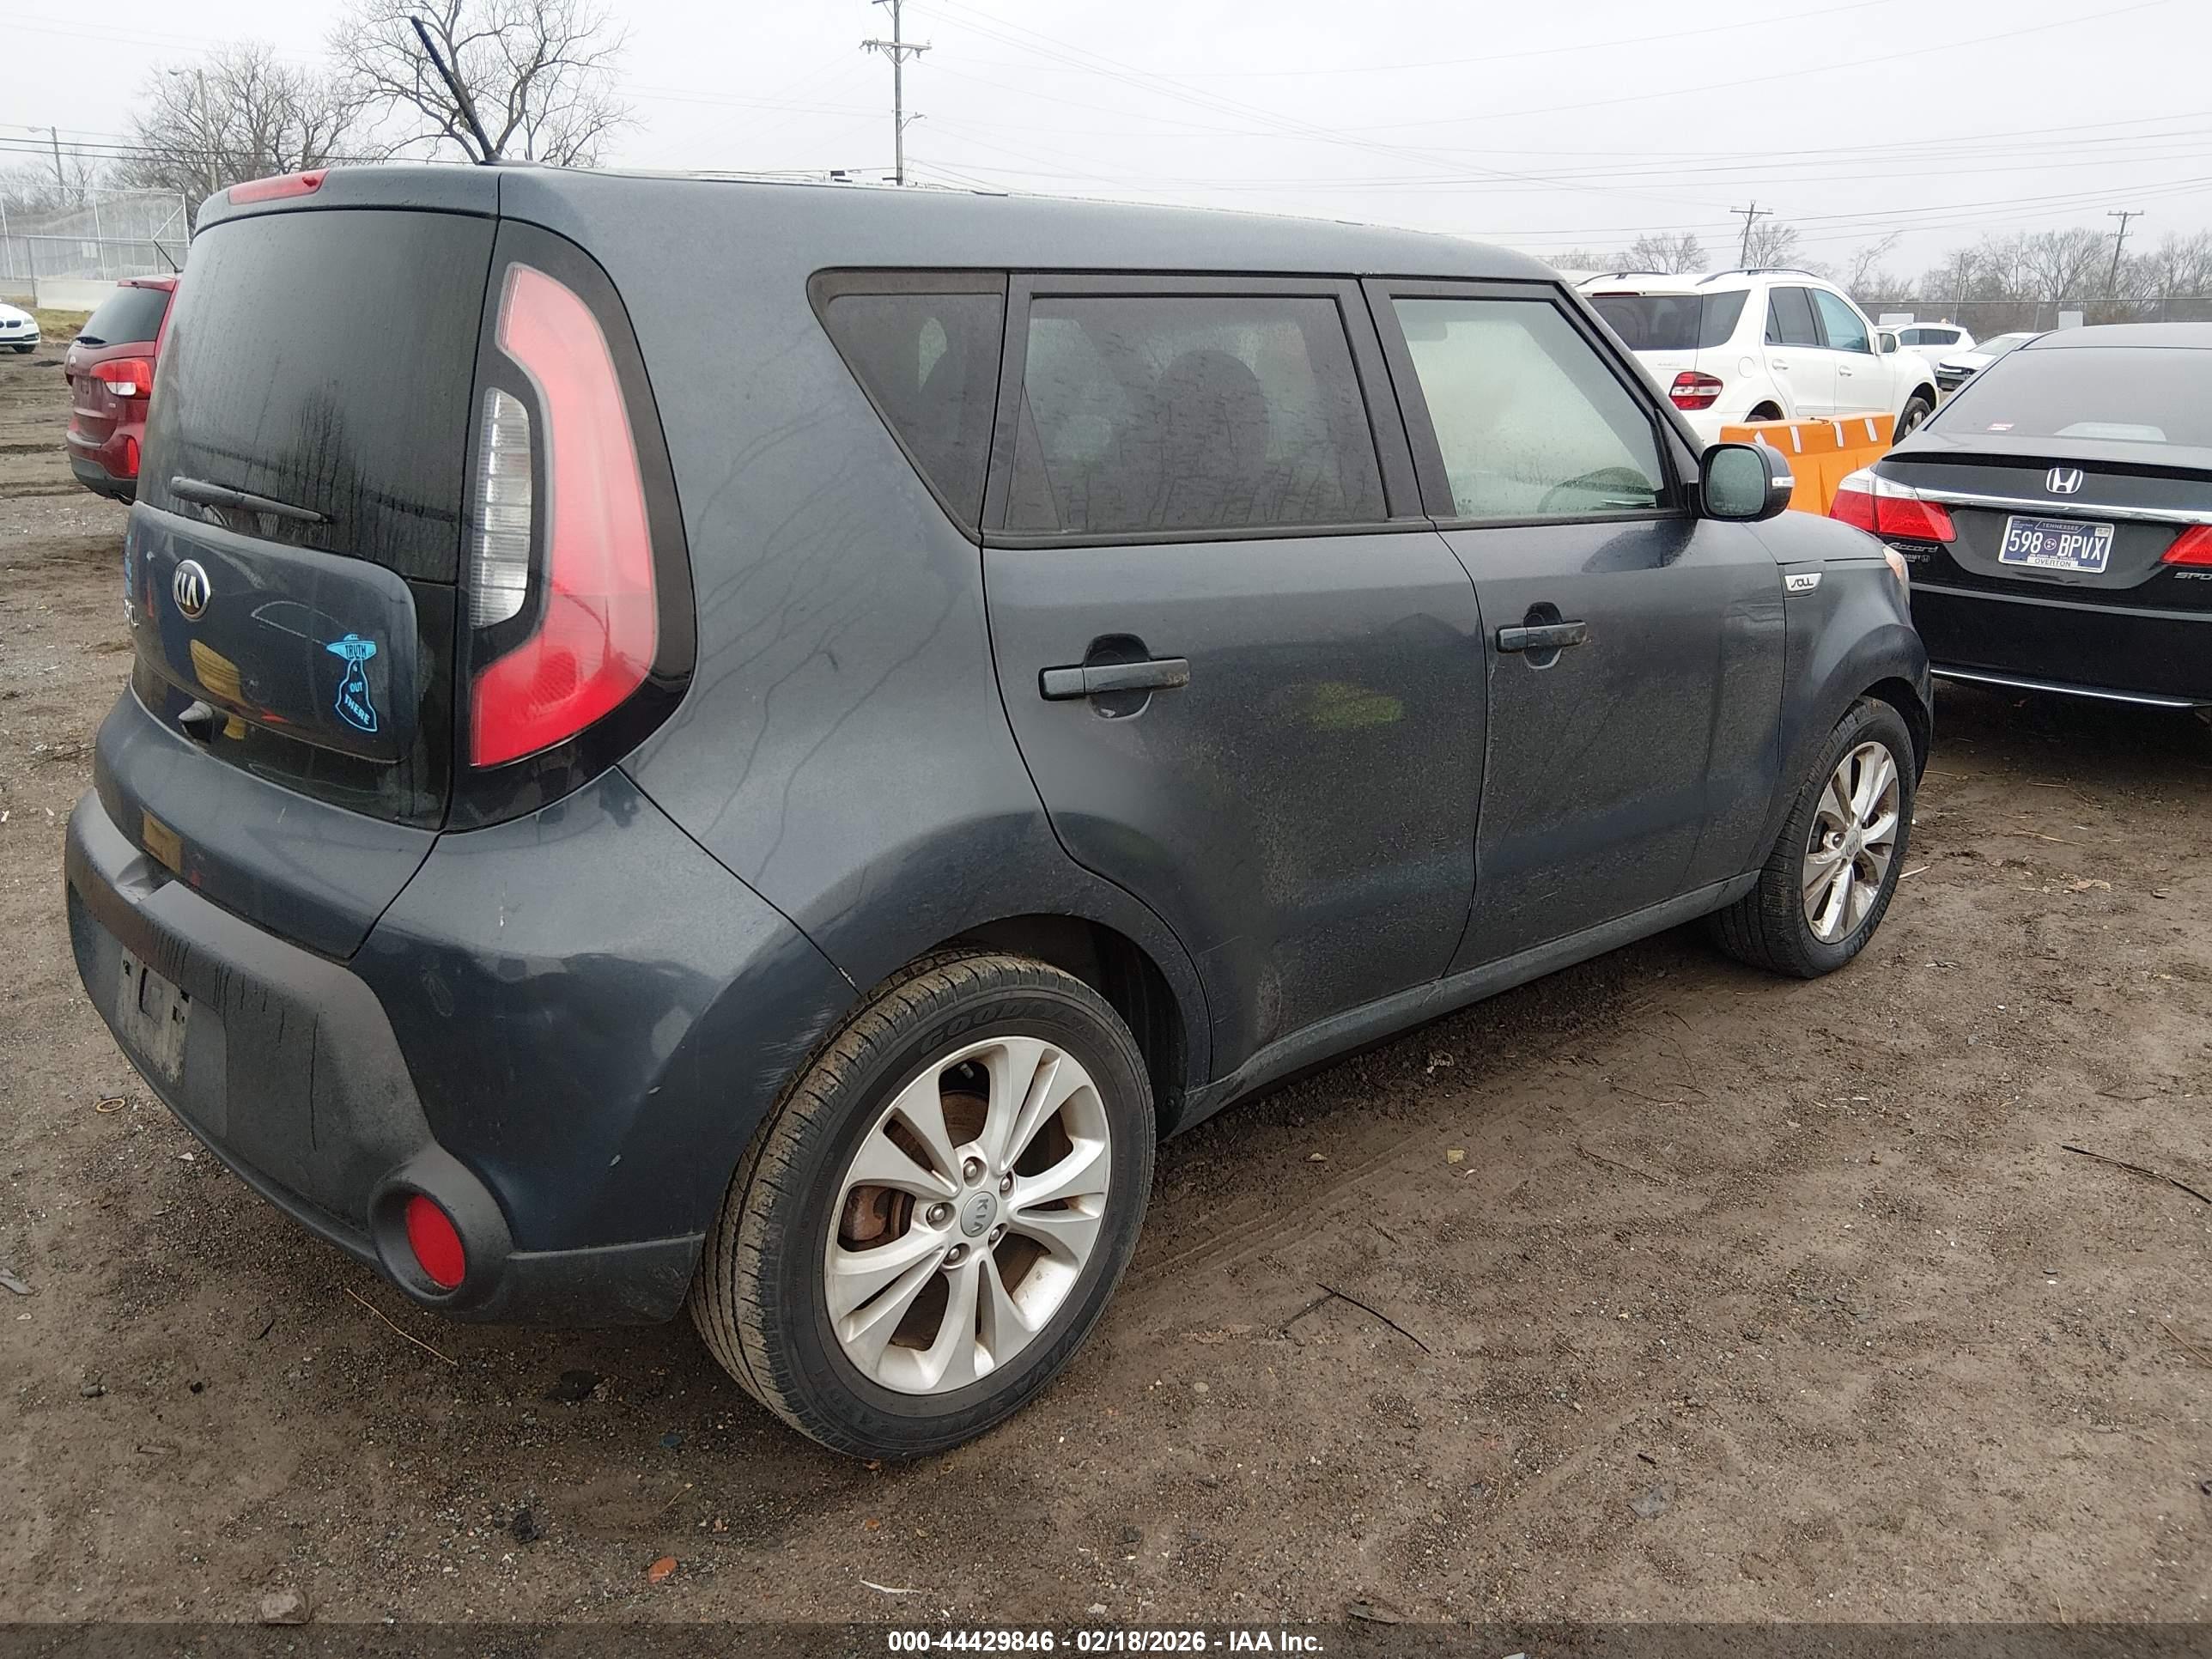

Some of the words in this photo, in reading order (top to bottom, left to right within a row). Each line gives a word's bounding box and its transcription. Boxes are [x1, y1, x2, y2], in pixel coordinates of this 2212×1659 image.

[2043, 522, 2080, 531] TENNESSEE
[1887, 542, 1939, 553] Accord
[2008, 530, 2044, 554] 598
[2057, 534, 2106, 561] BPVX
[2034, 557, 2072, 568] OVERTON
[344, 644, 367, 659] TRUTH
[349, 682, 363, 693] OUT
[344, 693, 371, 726] THERE
